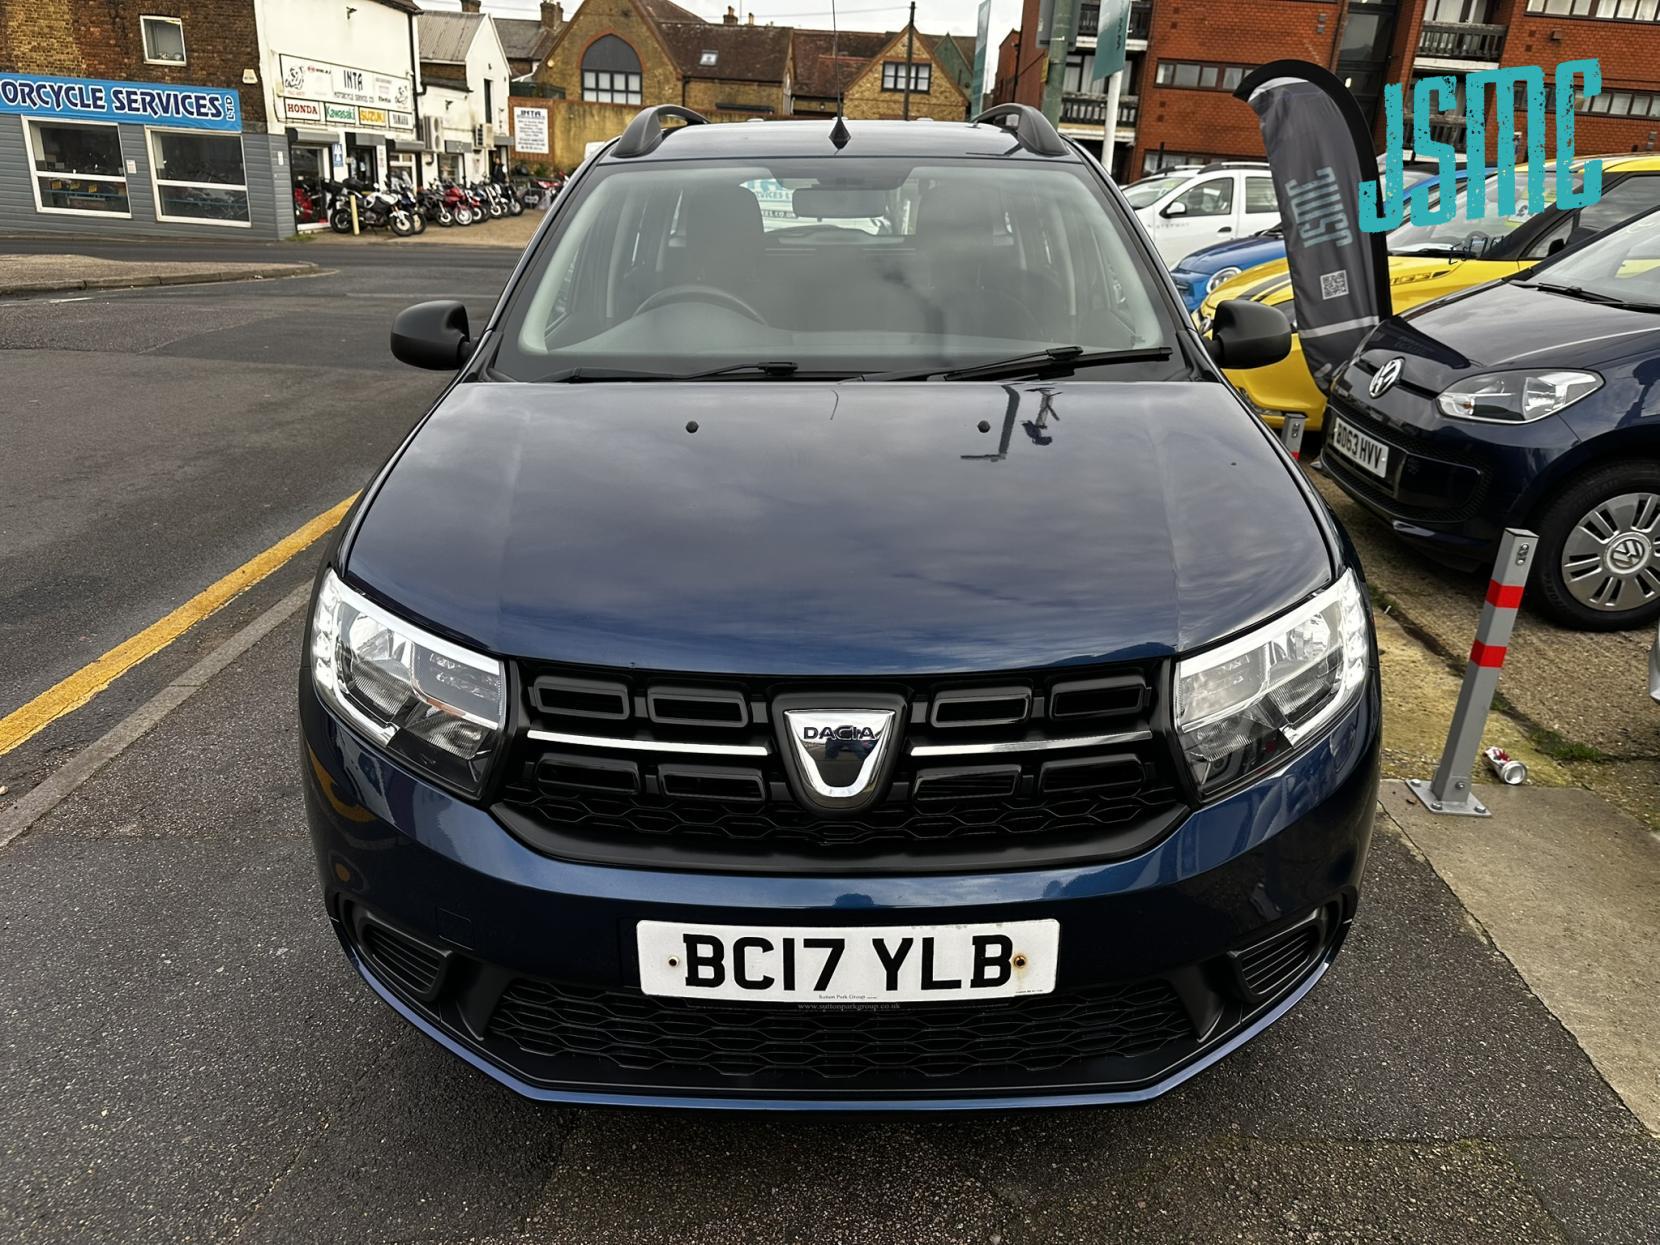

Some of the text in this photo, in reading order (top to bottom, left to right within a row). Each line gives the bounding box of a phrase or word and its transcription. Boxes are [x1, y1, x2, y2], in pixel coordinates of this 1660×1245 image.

[343, 69, 364, 91] INTA
[0, 79, 236, 121] ORCYCLE SERVICES LTD
[287, 103, 318, 115] HONDA
[326, 105, 355, 121] Kawasaki
[1285, 166, 1353, 248] JSMC
[804, 725, 875, 740] DACIA
[683, 933, 1014, 991] BC17 YLB
